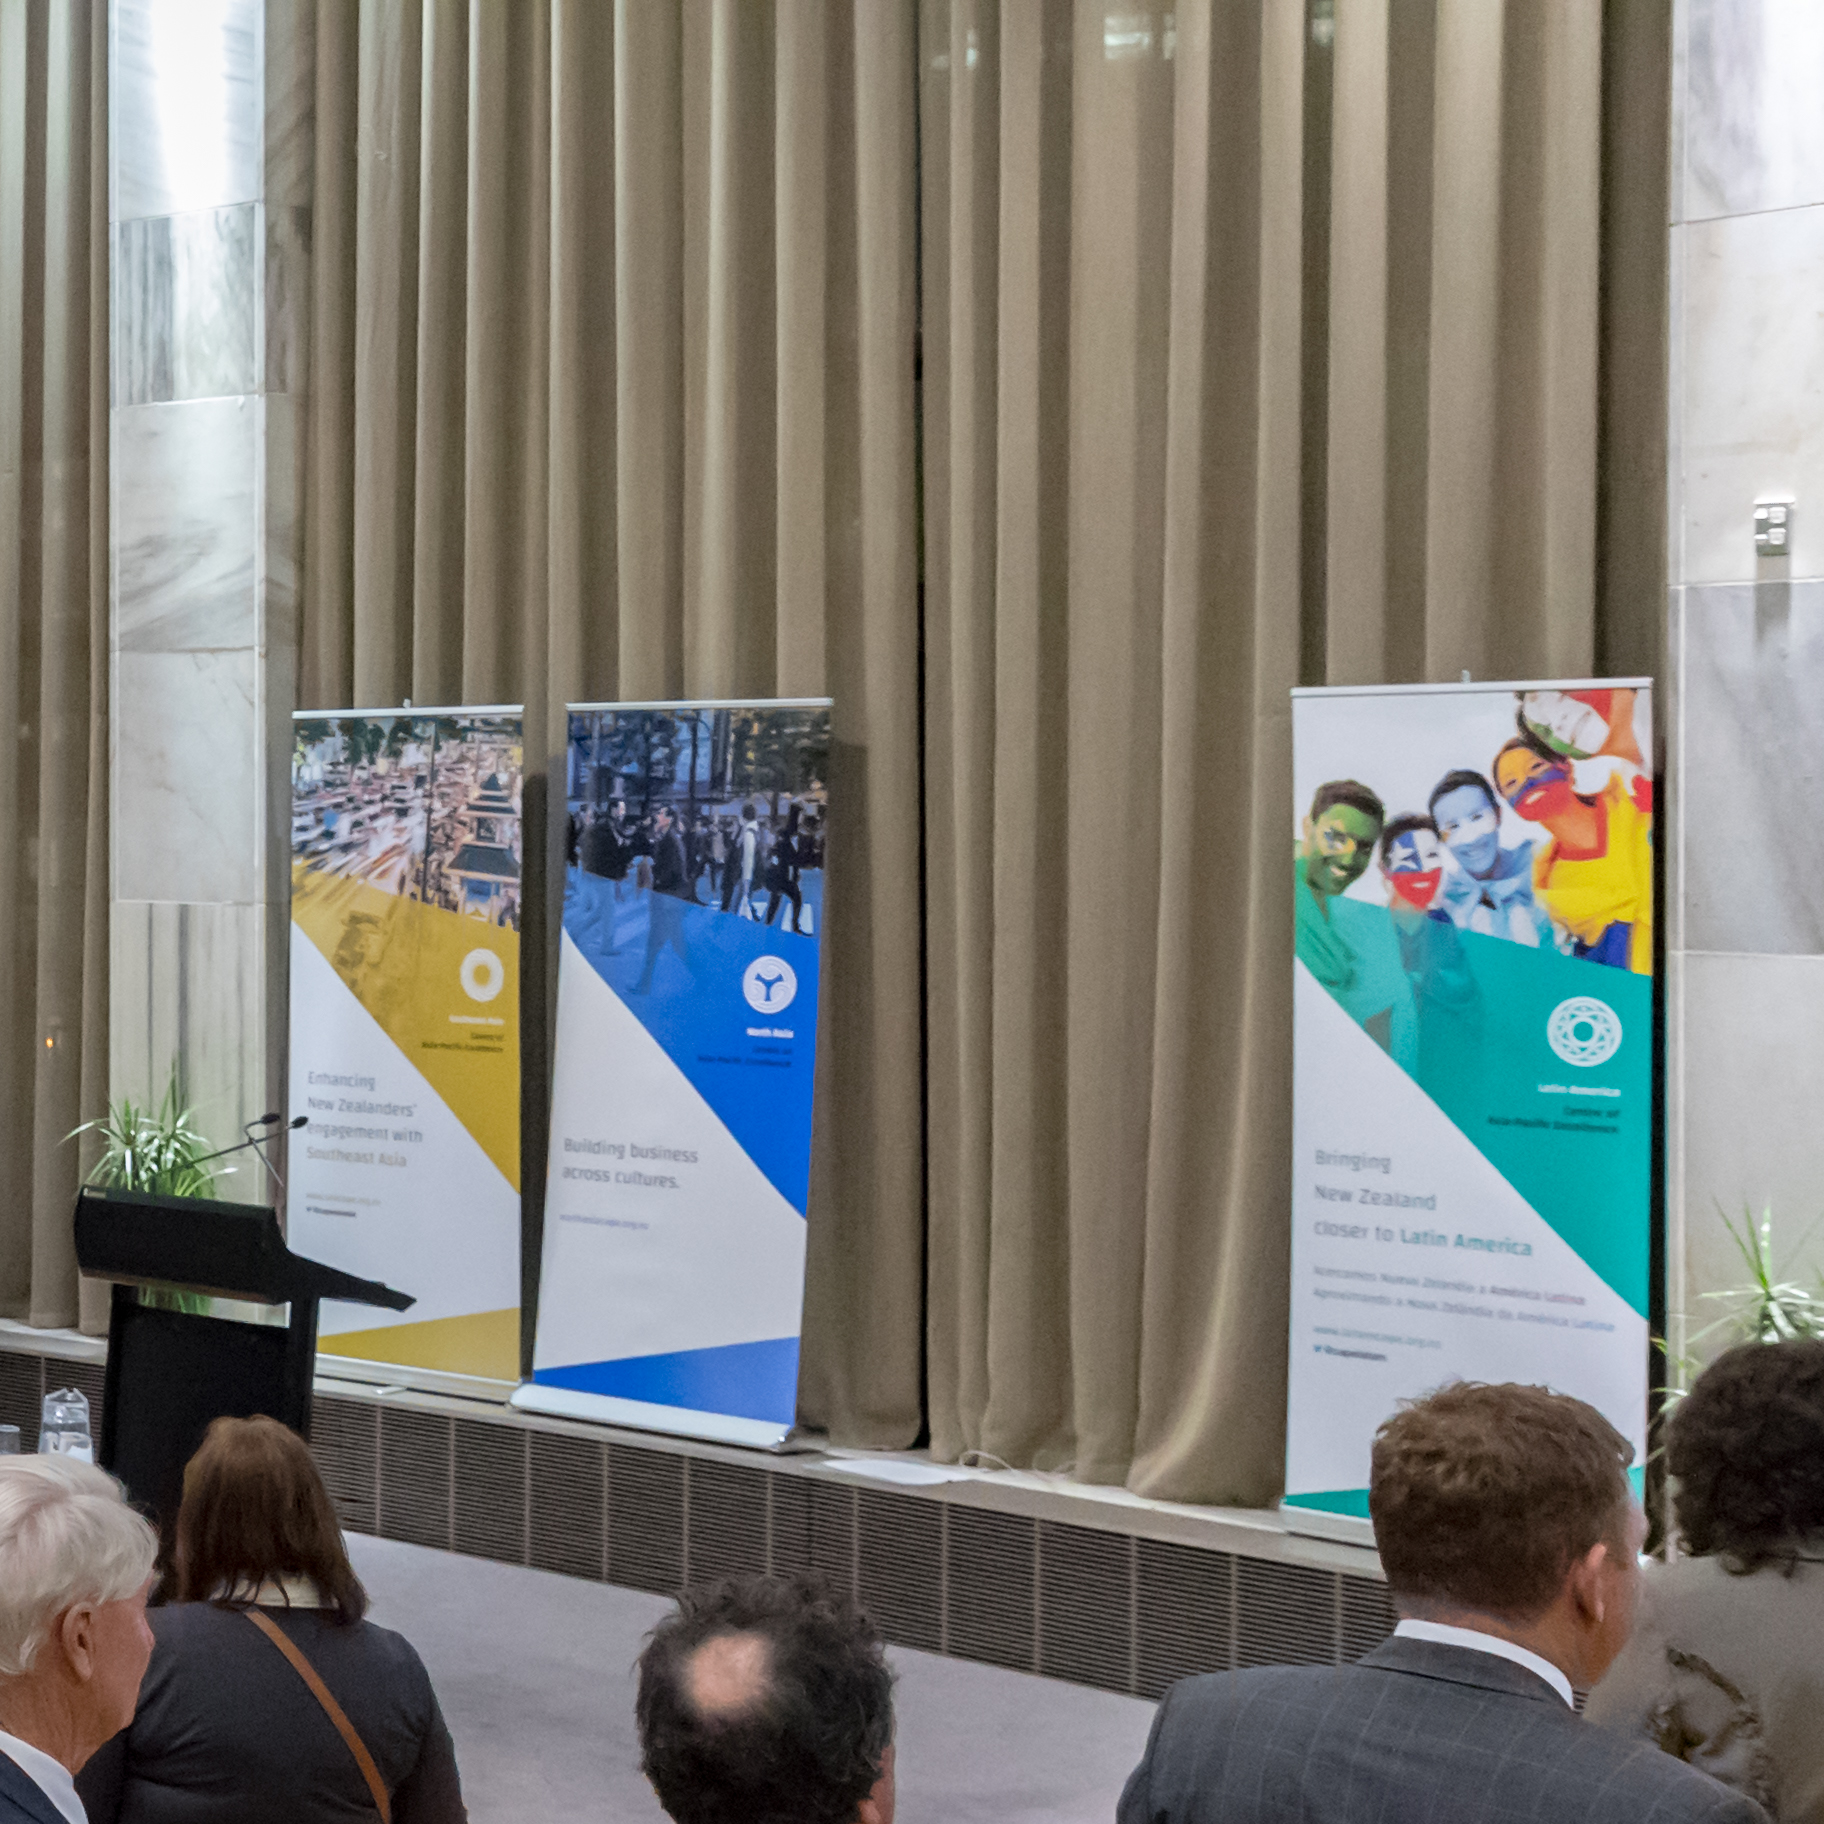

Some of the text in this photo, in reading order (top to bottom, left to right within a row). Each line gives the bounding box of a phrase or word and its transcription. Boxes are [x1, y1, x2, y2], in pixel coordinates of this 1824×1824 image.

[308, 1071, 376, 1092] Enhancing
[308, 1096, 334, 1111] New
[307, 1122, 423, 1143] engagement with
[307, 1146, 407, 1167] Southeast Asia
[563, 1137, 699, 1164] Building business
[1315, 1149, 1391, 1174] Bringing
[562, 1166, 680, 1189] across cultures.
[1314, 1184, 1437, 1211] New Zealand
[1313, 1220, 1533, 1257] closer to Latin America
